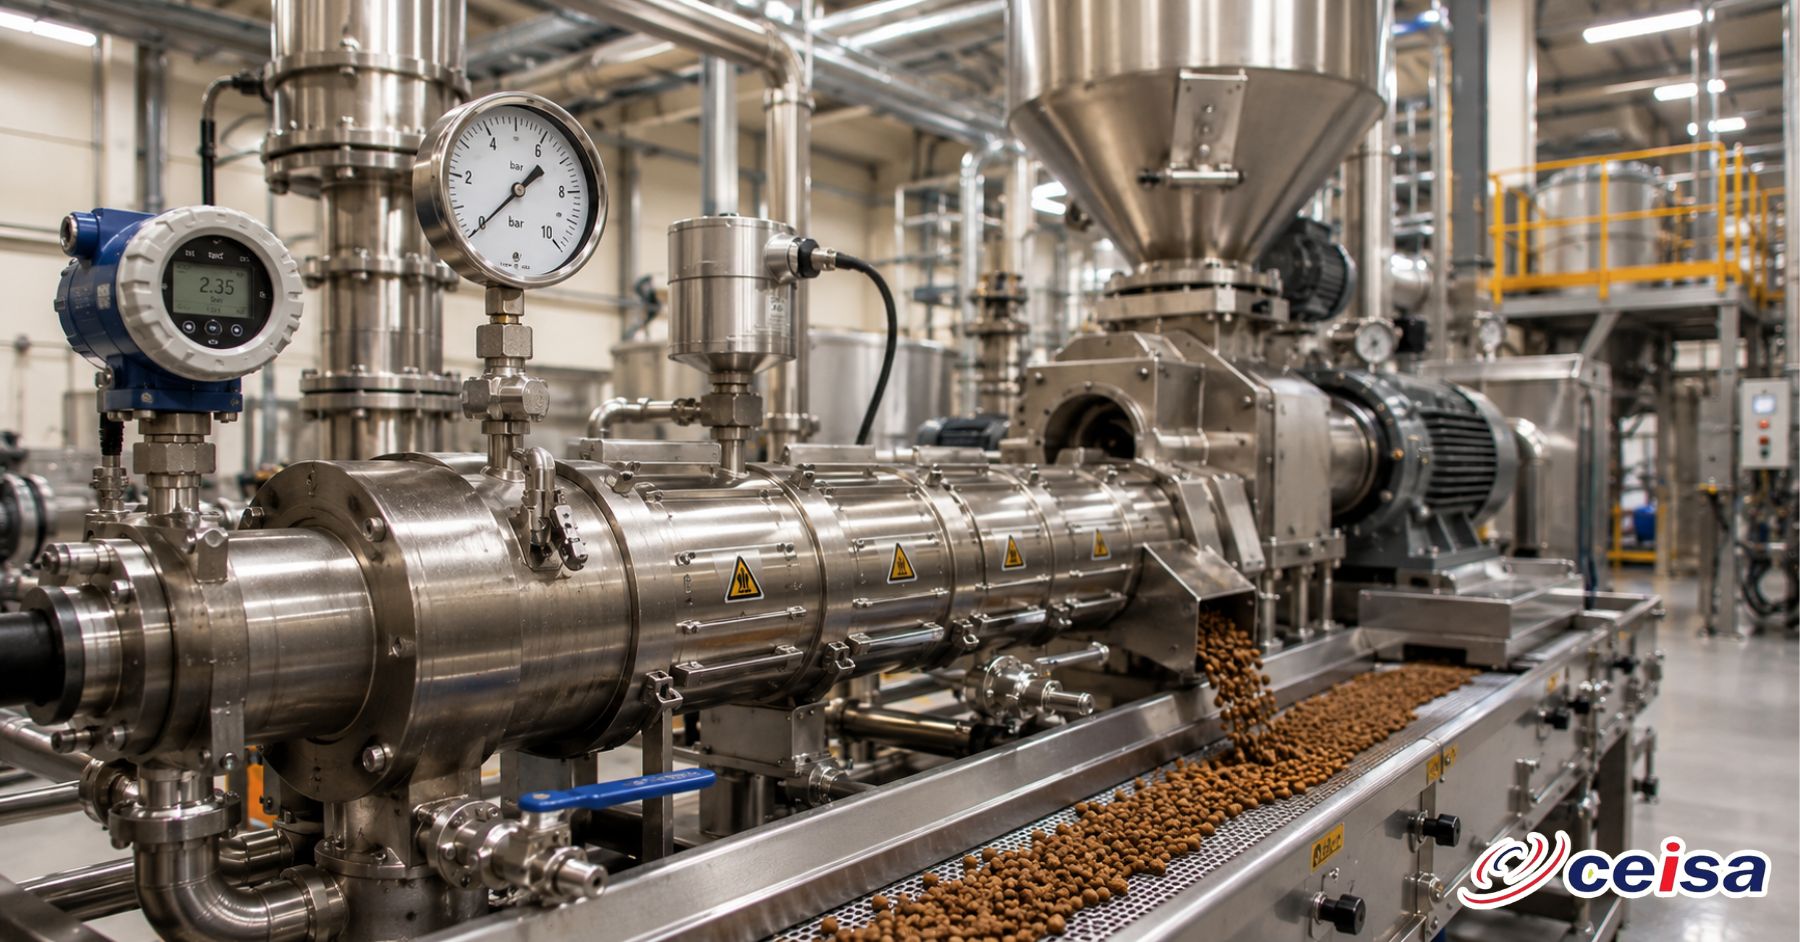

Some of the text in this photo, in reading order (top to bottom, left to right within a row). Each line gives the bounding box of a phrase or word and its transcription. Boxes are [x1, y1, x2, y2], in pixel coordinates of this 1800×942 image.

[490, 137, 497, 151] 4
[535, 144, 542, 158] 6
[510, 161, 523, 172] bar
[465, 170, 472, 185] 2
[558, 185, 565, 198] 8
[478, 216, 486, 230] 0
[509, 215, 525, 229] bar
[541, 225, 553, 239] 10
[199, 276, 235, 296] 2.35
